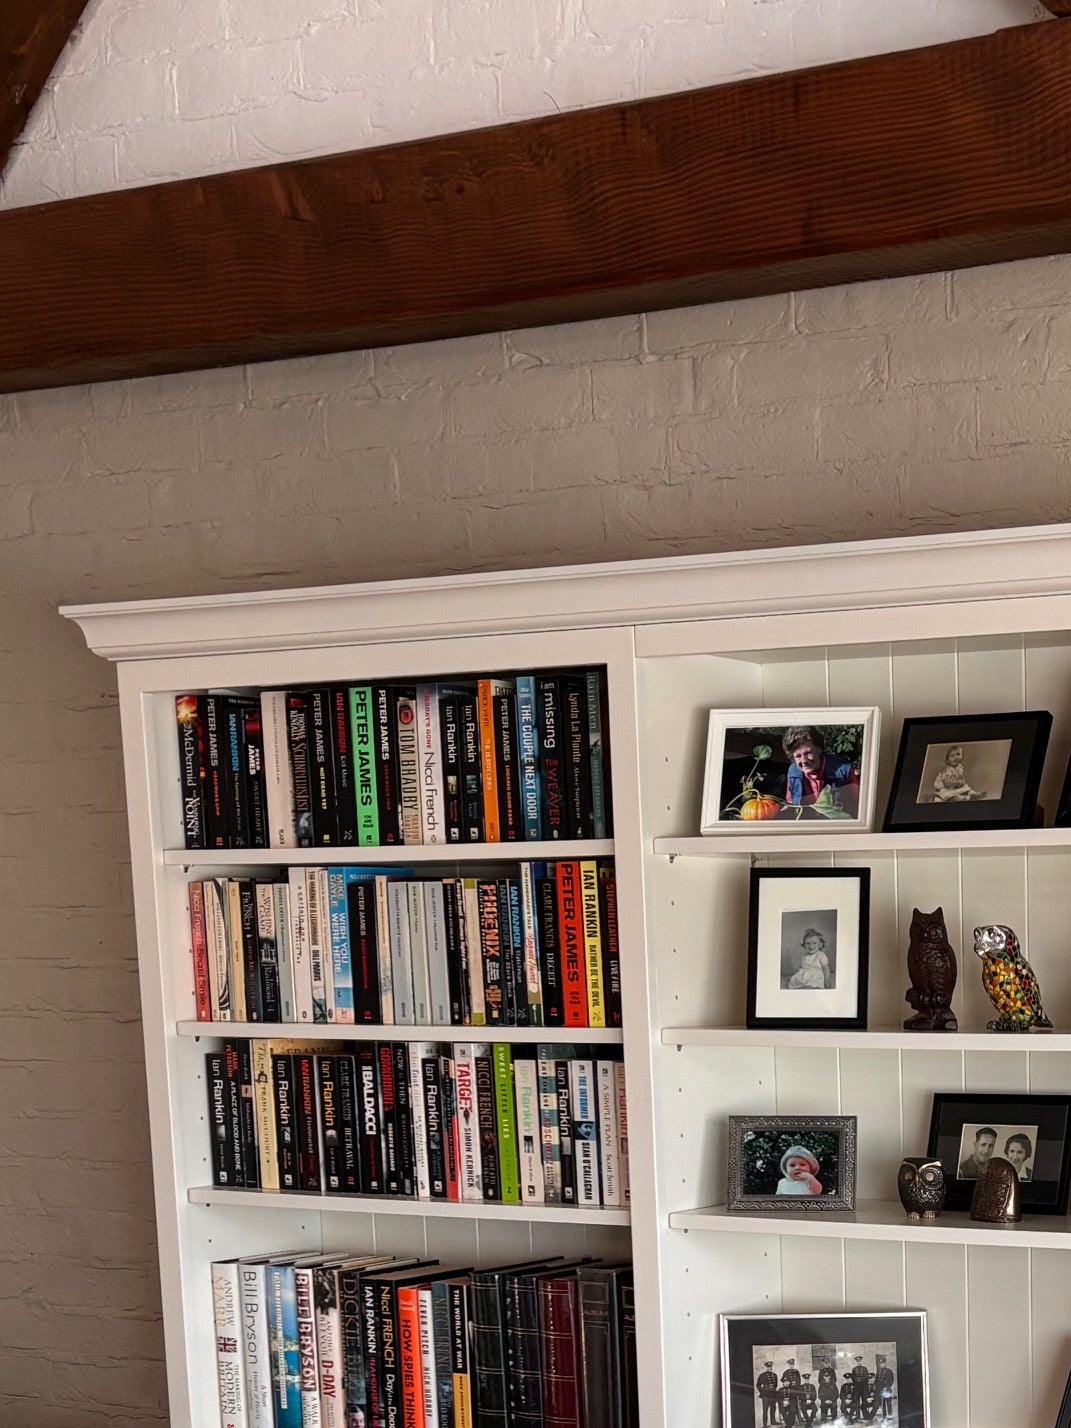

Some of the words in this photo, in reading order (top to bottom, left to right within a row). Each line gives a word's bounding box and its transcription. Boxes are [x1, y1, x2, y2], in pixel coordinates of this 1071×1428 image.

[355, 691, 369, 745] PETER
[446, 706, 454, 721] Ian
[521, 704, 532, 722] THE
[545, 693, 556, 748] missing
[183, 729, 196, 786] McDermid
[400, 728, 415, 756] TOM
[447, 724, 457, 763] Rankin
[522, 725, 534, 763] COUPLE
[358, 750, 372, 806] JAMES
[401, 760, 416, 810] BRADBY
[424, 752, 435, 785] Nicci
[525, 766, 535, 789] NEXT
[425, 789, 439, 830] French
[527, 792, 537, 819] DOOR
[548, 768, 560, 825] WEAVER
[561, 864, 576, 920] PETER
[583, 870, 595, 889] IAN
[584, 894, 598, 938] RANKIN
[565, 924, 579, 982] JAMES
[589, 945, 597, 968] RATHER
[591, 979, 599, 989] THE
[592, 991, 600, 1007] DEVIL
[212, 1060, 221, 1076] Ian
[277, 1060, 286, 1077] Ian
[214, 1080, 225, 1123] Rankin
[278, 1081, 290, 1124] Rankin
[363, 1072, 376, 1135] BALDACCI
[344, 1128, 354, 1169] BETRAYAL
[464, 1128, 472, 1152] SIMON
[466, 1155, 475, 1188] KERNICK
[243, 1272, 259, 1297] Bill
[365, 1287, 374, 1306] IAN
[245, 1303, 262, 1364] Bryson
[366, 1310, 376, 1353] RANKIN
[402, 1319, 411, 1352] HOW
[454, 1308, 462, 1336] WORLD
[456, 1338, 462, 1348] AT
[404, 1356, 414, 1388] SPIES
